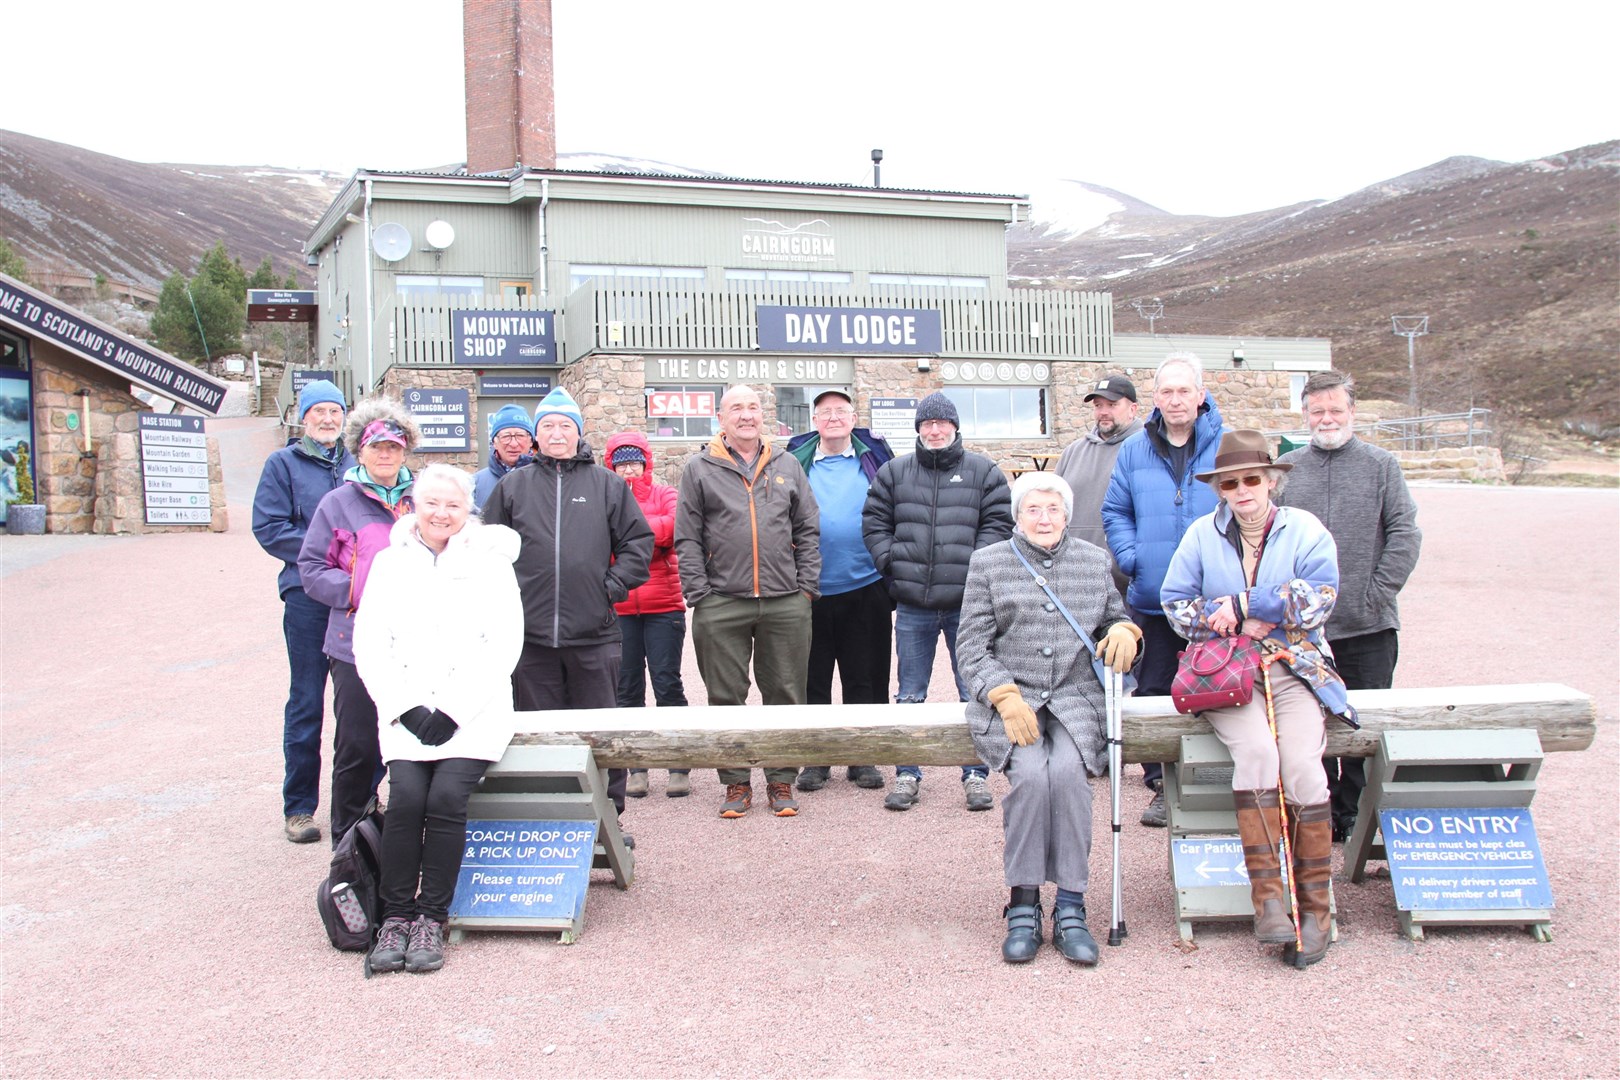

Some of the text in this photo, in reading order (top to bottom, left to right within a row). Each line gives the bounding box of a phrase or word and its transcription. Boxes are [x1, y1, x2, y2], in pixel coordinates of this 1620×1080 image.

[742, 234, 835, 255] CAIRNGORM
[463, 316, 546, 336] MOUNTAIN
[785, 313, 916, 345] DAY LODGE
[463, 337, 507, 357] SHOP
[24, 302, 42, 322] TO
[42, 311, 115, 357] SCOTLAND'S
[115, 347, 174, 385] MOUNTAIN
[173, 375, 221, 407] RAILWAY
[658, 359, 838, 379] THE CAS BAR & SHOP
[411, 403, 463, 412] CAIRNGORM CAFÉ
[653, 395, 711, 414] SALE
[142, 416, 182, 428] BASE STATION
[144, 432, 192, 444] Mountain Railway
[145, 448, 191, 458] Mountain Garden
[147, 465, 184, 474] Walking Trails
[148, 480, 160, 488] Bike
[149, 495, 182, 505] Ranger Base
[150, 511, 169, 519] Toilets
[1391, 815, 1519, 834] NO ENTRY
[519, 831, 561, 842] DROP
[563, 830, 593, 842] OFF
[1180, 843, 1244, 854] Car Parkin
[1415, 841, 1436, 849] area
[1439, 841, 1464, 849] must
[1465, 840, 1478, 849] be
[1480, 840, 1503, 850] kept
[465, 846, 581, 859] & PICK UP ONLY
[1393, 850, 1535, 860] for EMERGENCY VEHICLES
[471, 873, 566, 886] Please turnoff
[1402, 877, 1538, 888] All delivery drivers contact
[474, 891, 553, 906] your engine
[1422, 888, 1522, 900] any member of staff
